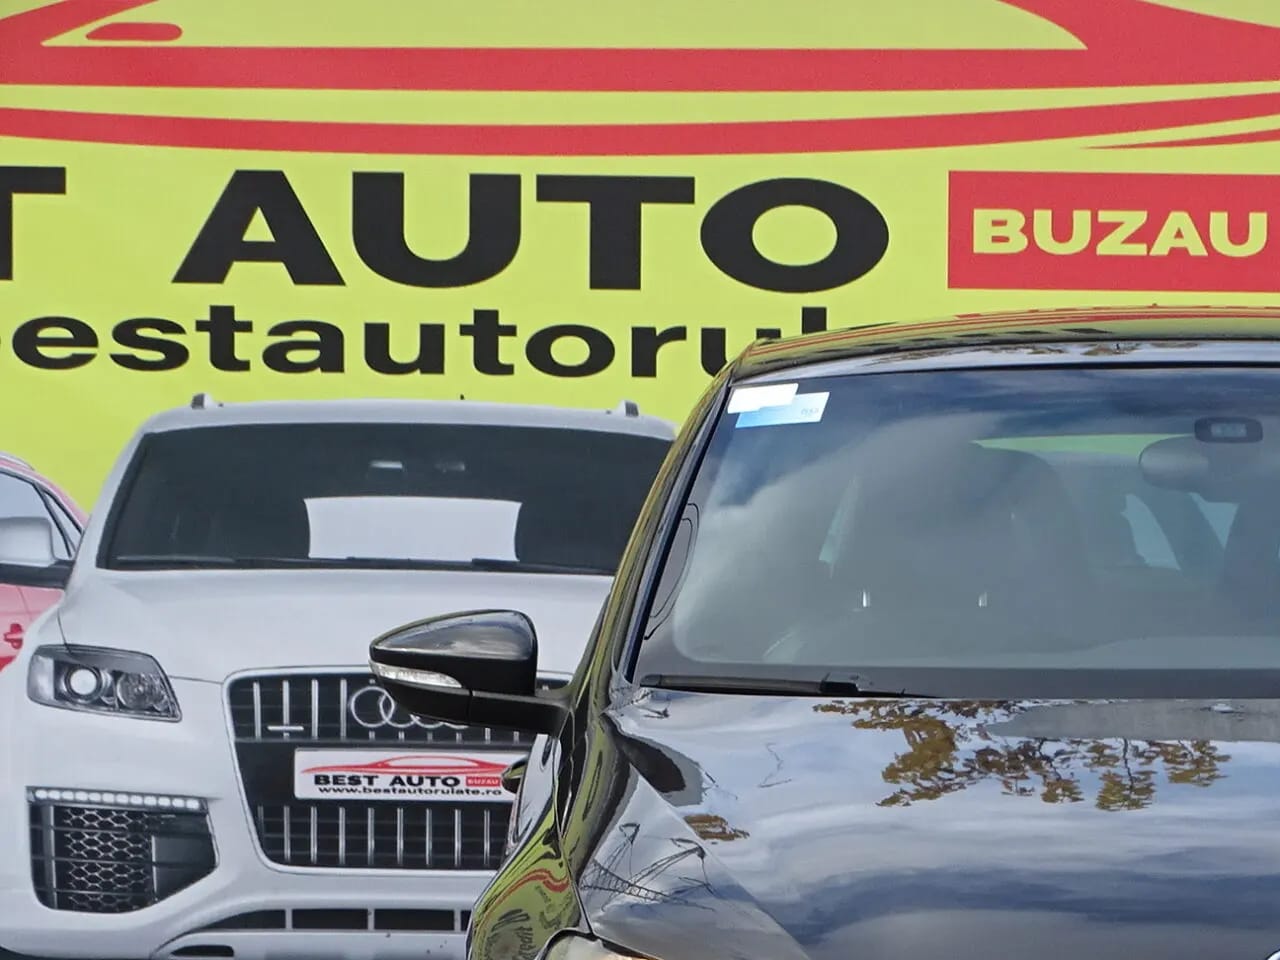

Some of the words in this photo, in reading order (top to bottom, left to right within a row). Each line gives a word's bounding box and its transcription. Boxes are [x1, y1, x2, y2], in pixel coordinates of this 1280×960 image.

[172, 169, 890, 293] AUTO
[972, 208, 1268, 258] BUZAU
[314, 774, 378, 786] BEST
[389, 776, 461, 786] AUTO
